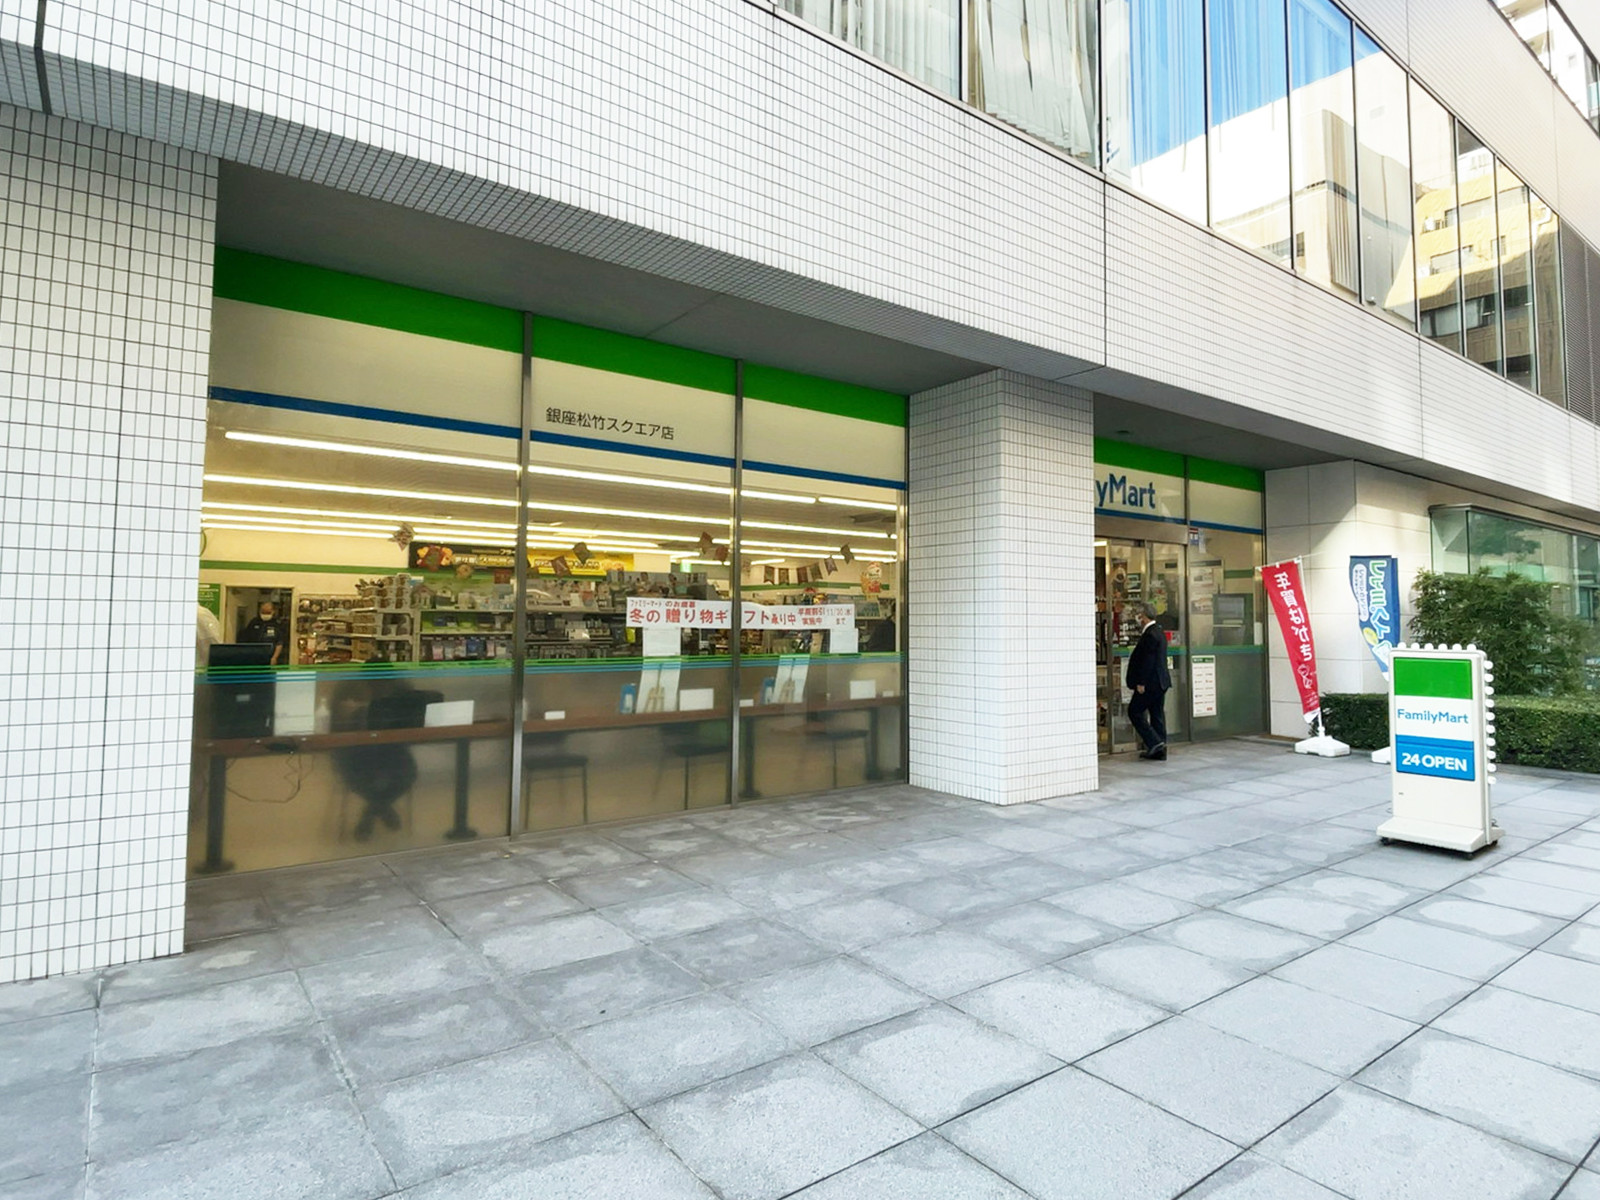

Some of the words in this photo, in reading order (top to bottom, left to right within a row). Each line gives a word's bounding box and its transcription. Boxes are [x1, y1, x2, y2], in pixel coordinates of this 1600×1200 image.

[546, 407, 675, 440] 銀座松竹スクエア店
[1397, 708, 1469, 724] FamilyMart
